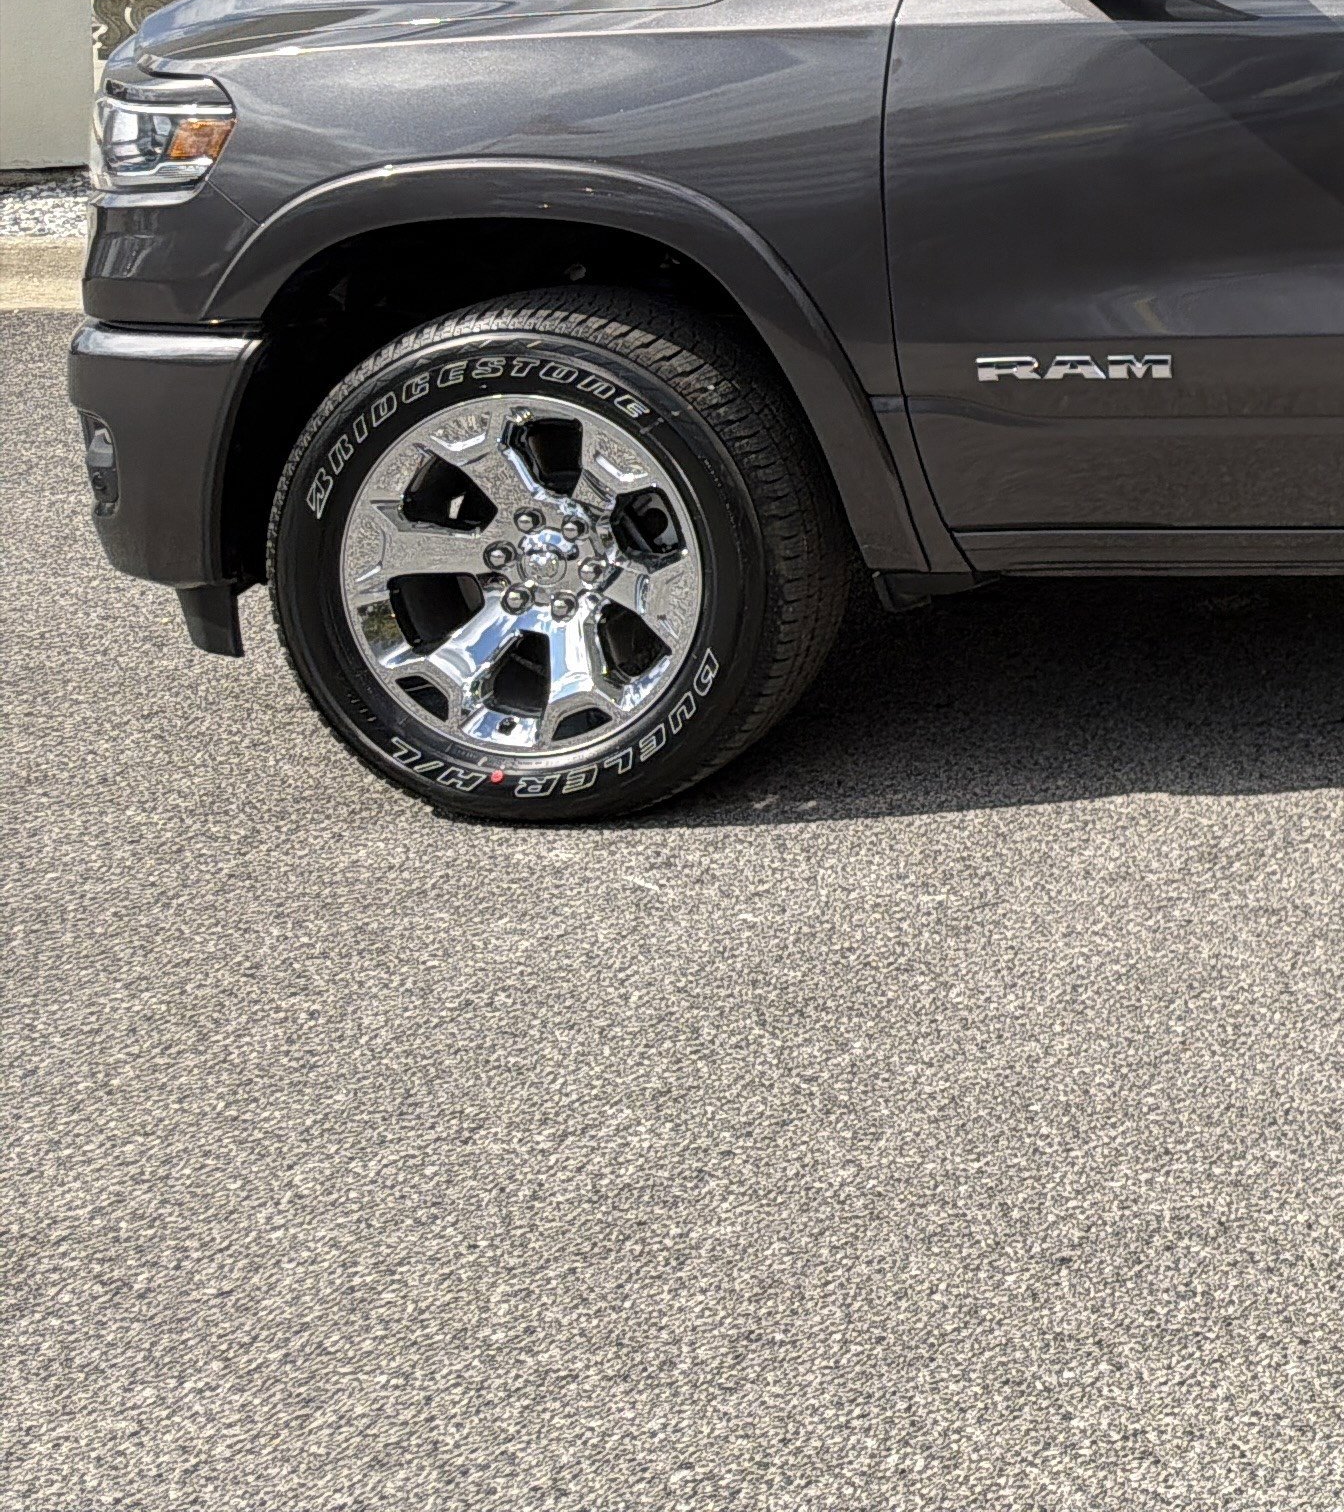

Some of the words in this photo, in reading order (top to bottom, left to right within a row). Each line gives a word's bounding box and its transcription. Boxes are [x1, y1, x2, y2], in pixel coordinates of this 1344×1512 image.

[975, 354, 1173, 382] RAM
[306, 356, 651, 519] BRIDGESTONE
[391, 736, 487, 791] H/L
[514, 647, 720, 798] DUELER
